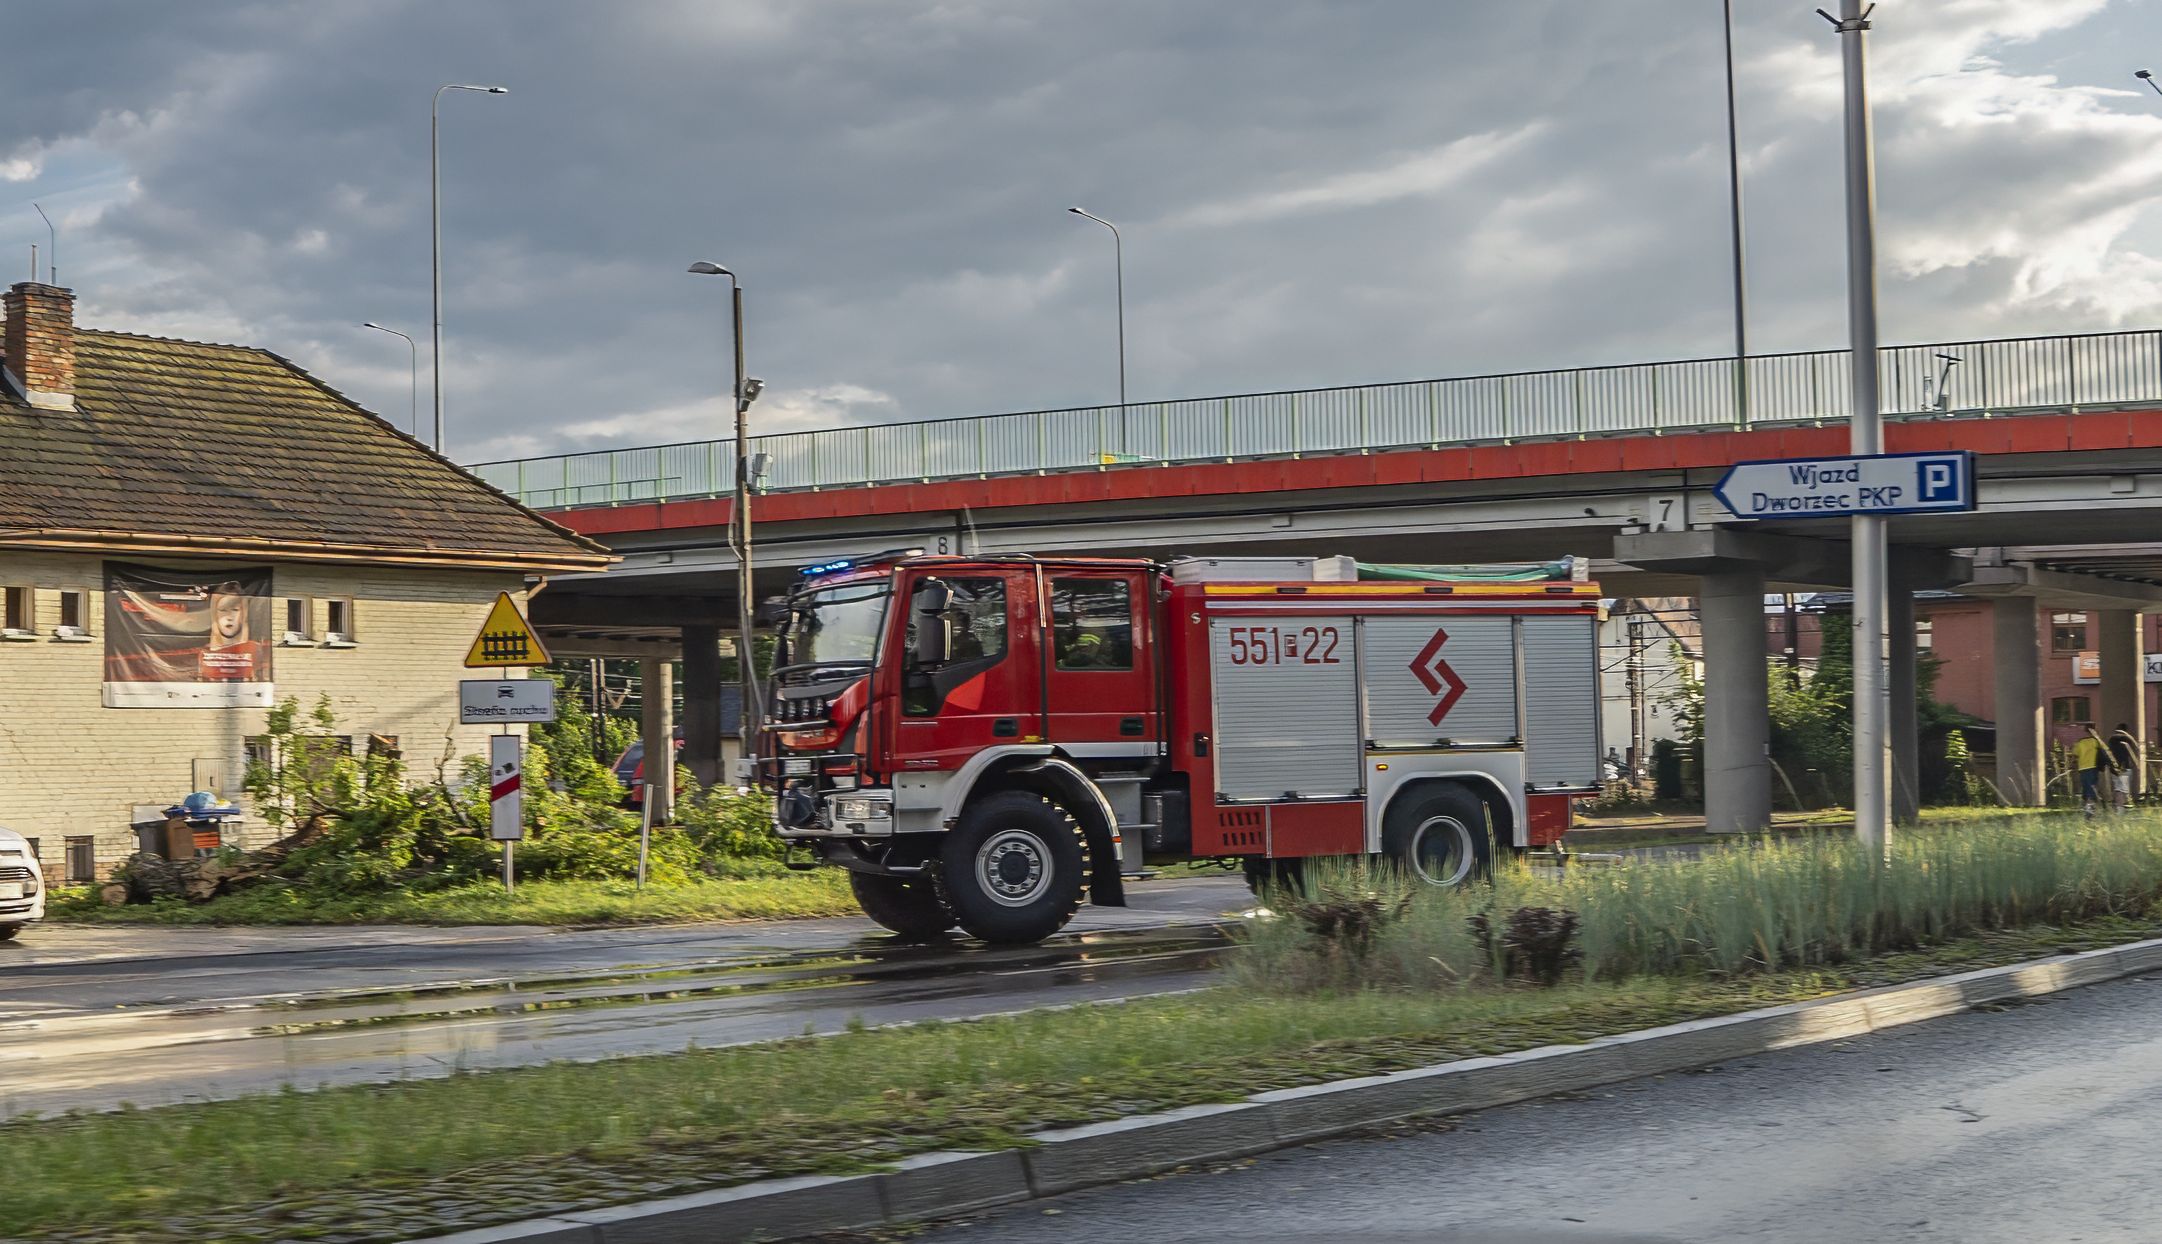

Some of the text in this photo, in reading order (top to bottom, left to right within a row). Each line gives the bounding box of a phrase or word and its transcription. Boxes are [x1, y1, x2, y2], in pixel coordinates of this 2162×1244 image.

[1788, 463, 1860, 489] Wjazd
[1925, 464, 1950, 497] P
[1658, 499, 1674, 522] 7
[1752, 486, 1902, 512] Dworzec PKP
[938, 536, 948, 555] 8
[1230, 627, 1280, 665] 551
[1302, 626, 1340, 664] 22
